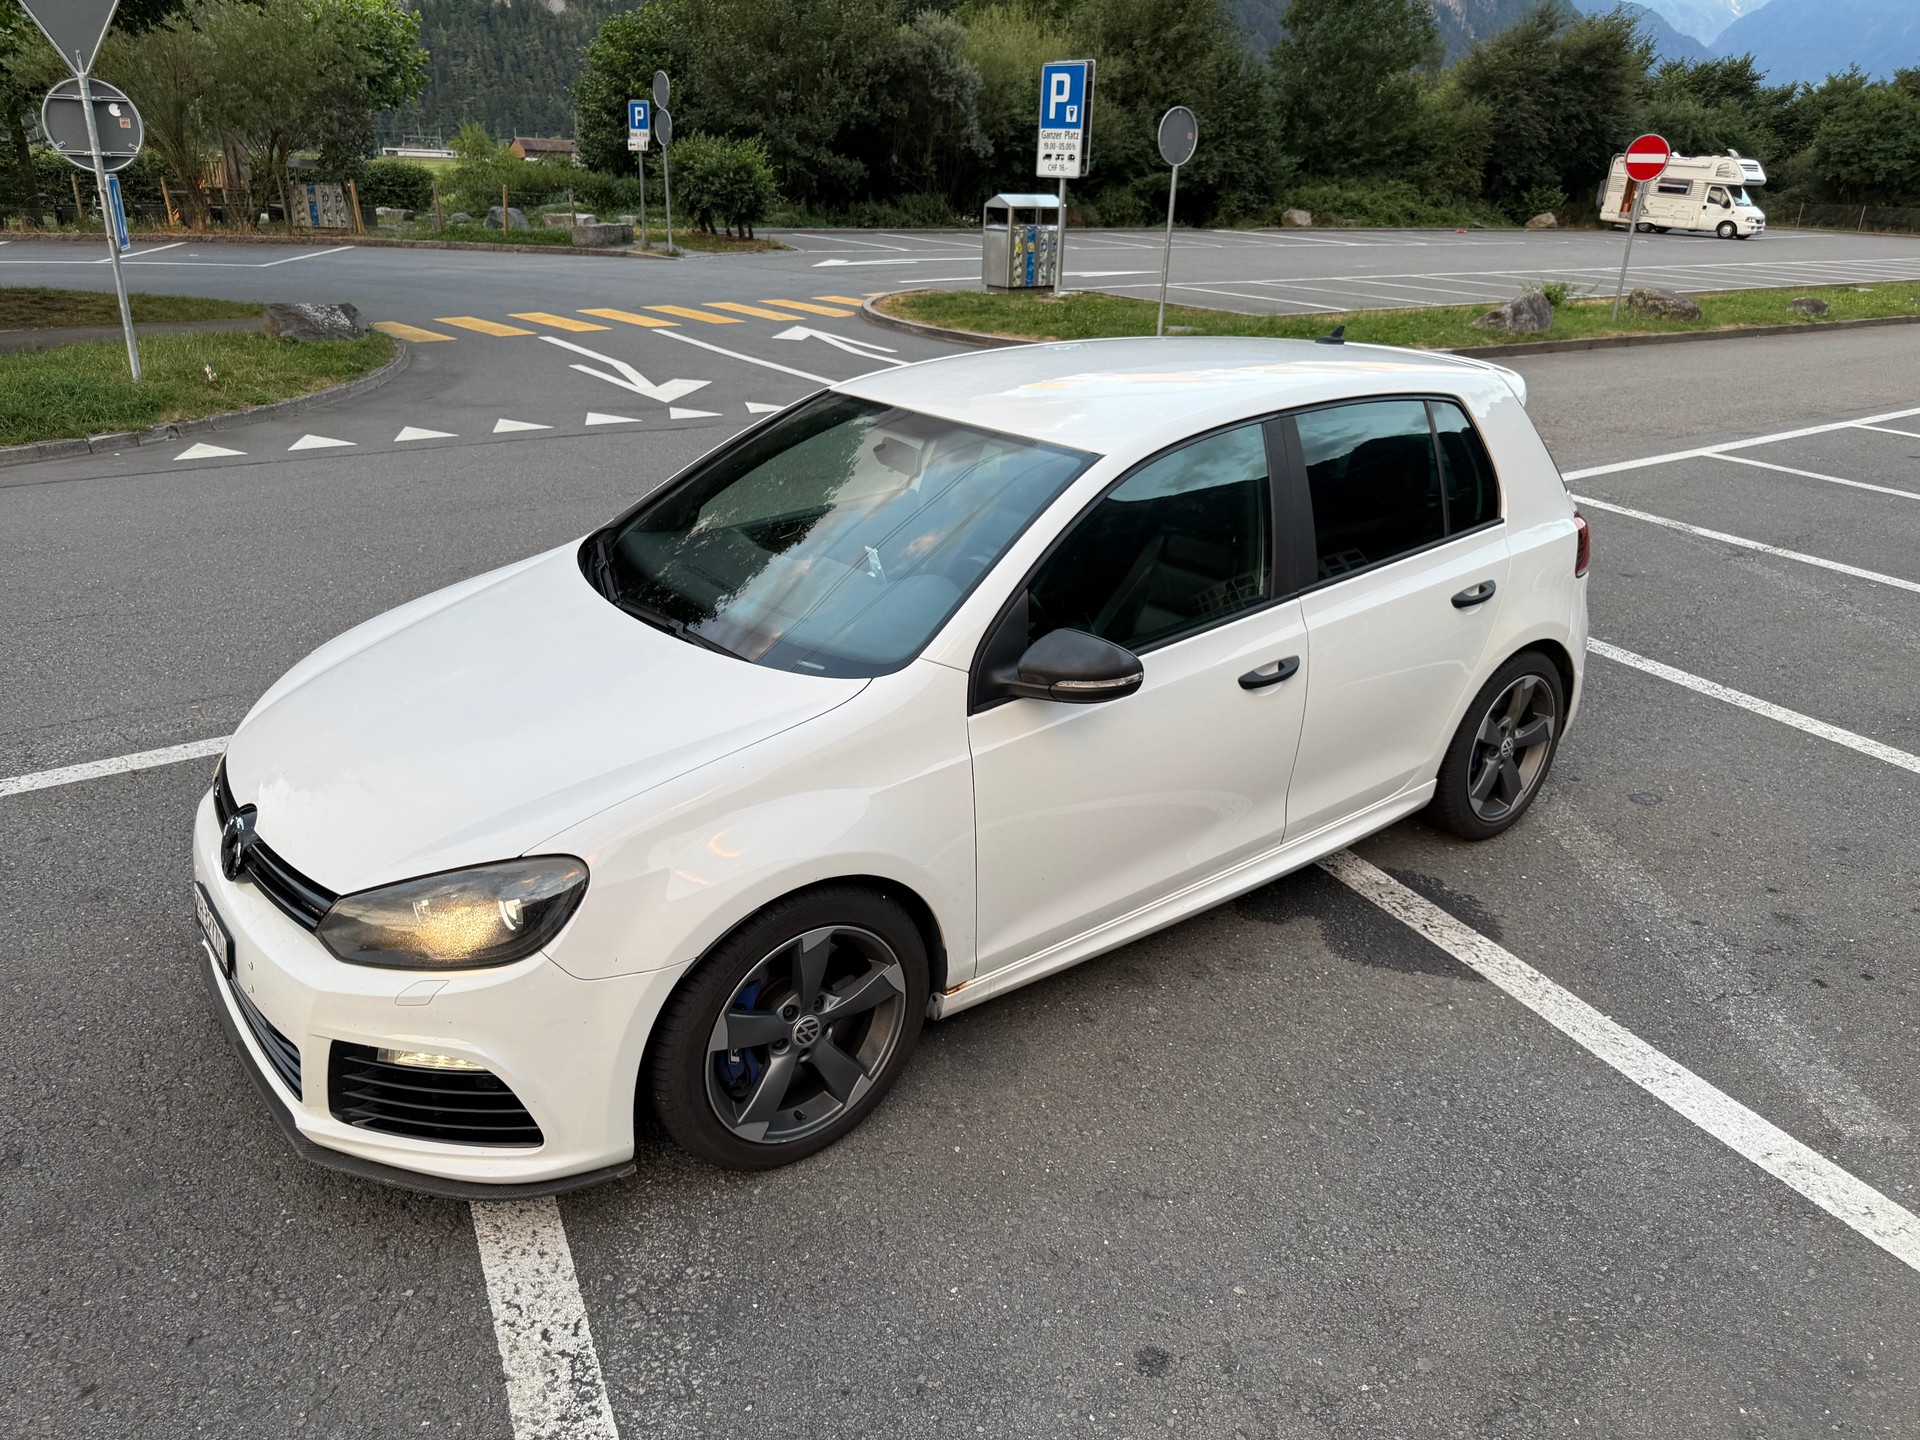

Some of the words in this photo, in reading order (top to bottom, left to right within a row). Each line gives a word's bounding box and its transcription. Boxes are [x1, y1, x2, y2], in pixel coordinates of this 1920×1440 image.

[1049, 73, 1071, 120] P
[634, 106, 644, 127] P
[1041, 130, 1062, 140] Ganzer
[1064, 130, 1080, 140] Platz
[1047, 163, 1058, 171] CHF
